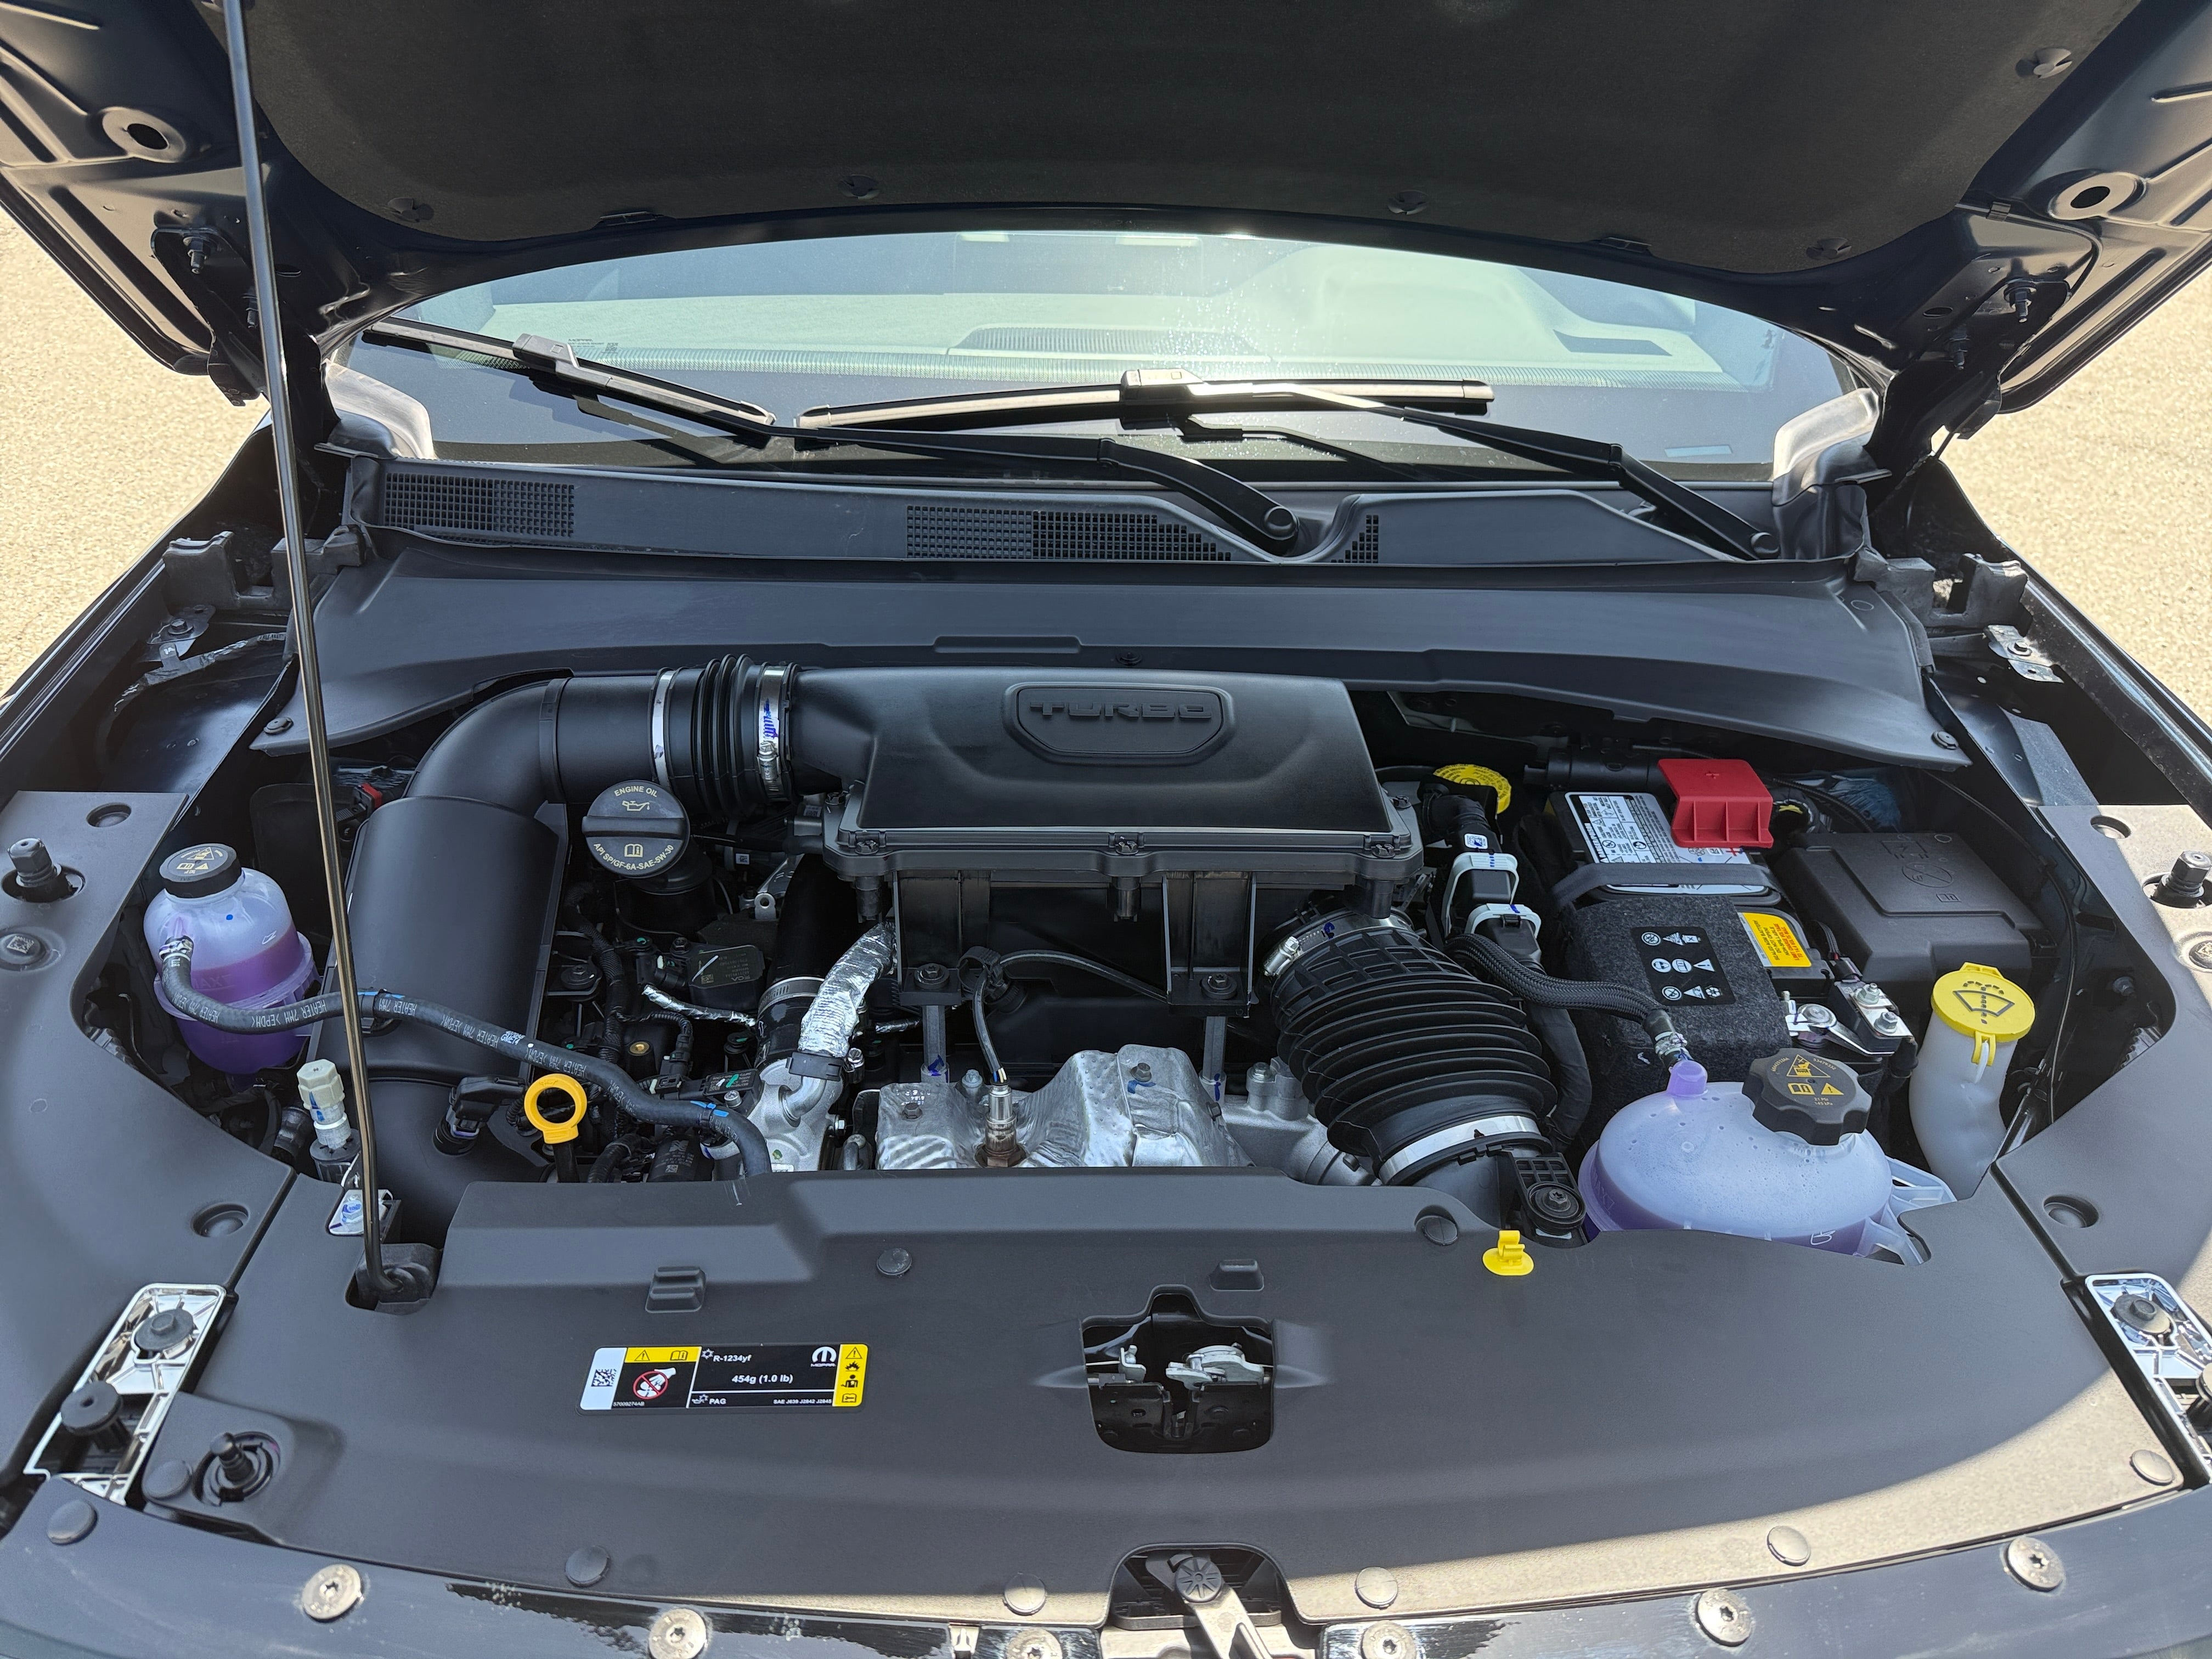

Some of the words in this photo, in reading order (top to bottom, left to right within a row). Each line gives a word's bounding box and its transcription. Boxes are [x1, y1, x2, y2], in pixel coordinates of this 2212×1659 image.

[1030, 701, 1212, 719] TURBO
[614, 786, 644, 797] ENGINE
[646, 788, 658, 797] OIL
[593, 843, 605, 855] API
[603, 844, 674, 870] SP/GF-6A-SAE-5W-30
[1752, 920, 1765, 936] BATTERY
[1767, 946, 1780, 960] SEALED
[199, 1005, 220, 1023] HEATER
[302, 999, 327, 1017] HEATER
[394, 1001, 417, 1016] HEATER
[476, 1029, 500, 1048] HEATER
[563, 1060, 587, 1078] HEATER
[732, 1375, 757, 1384] 454g
[759, 1375, 777, 1384] (1.0
[780, 1374, 793, 1384] lb)
